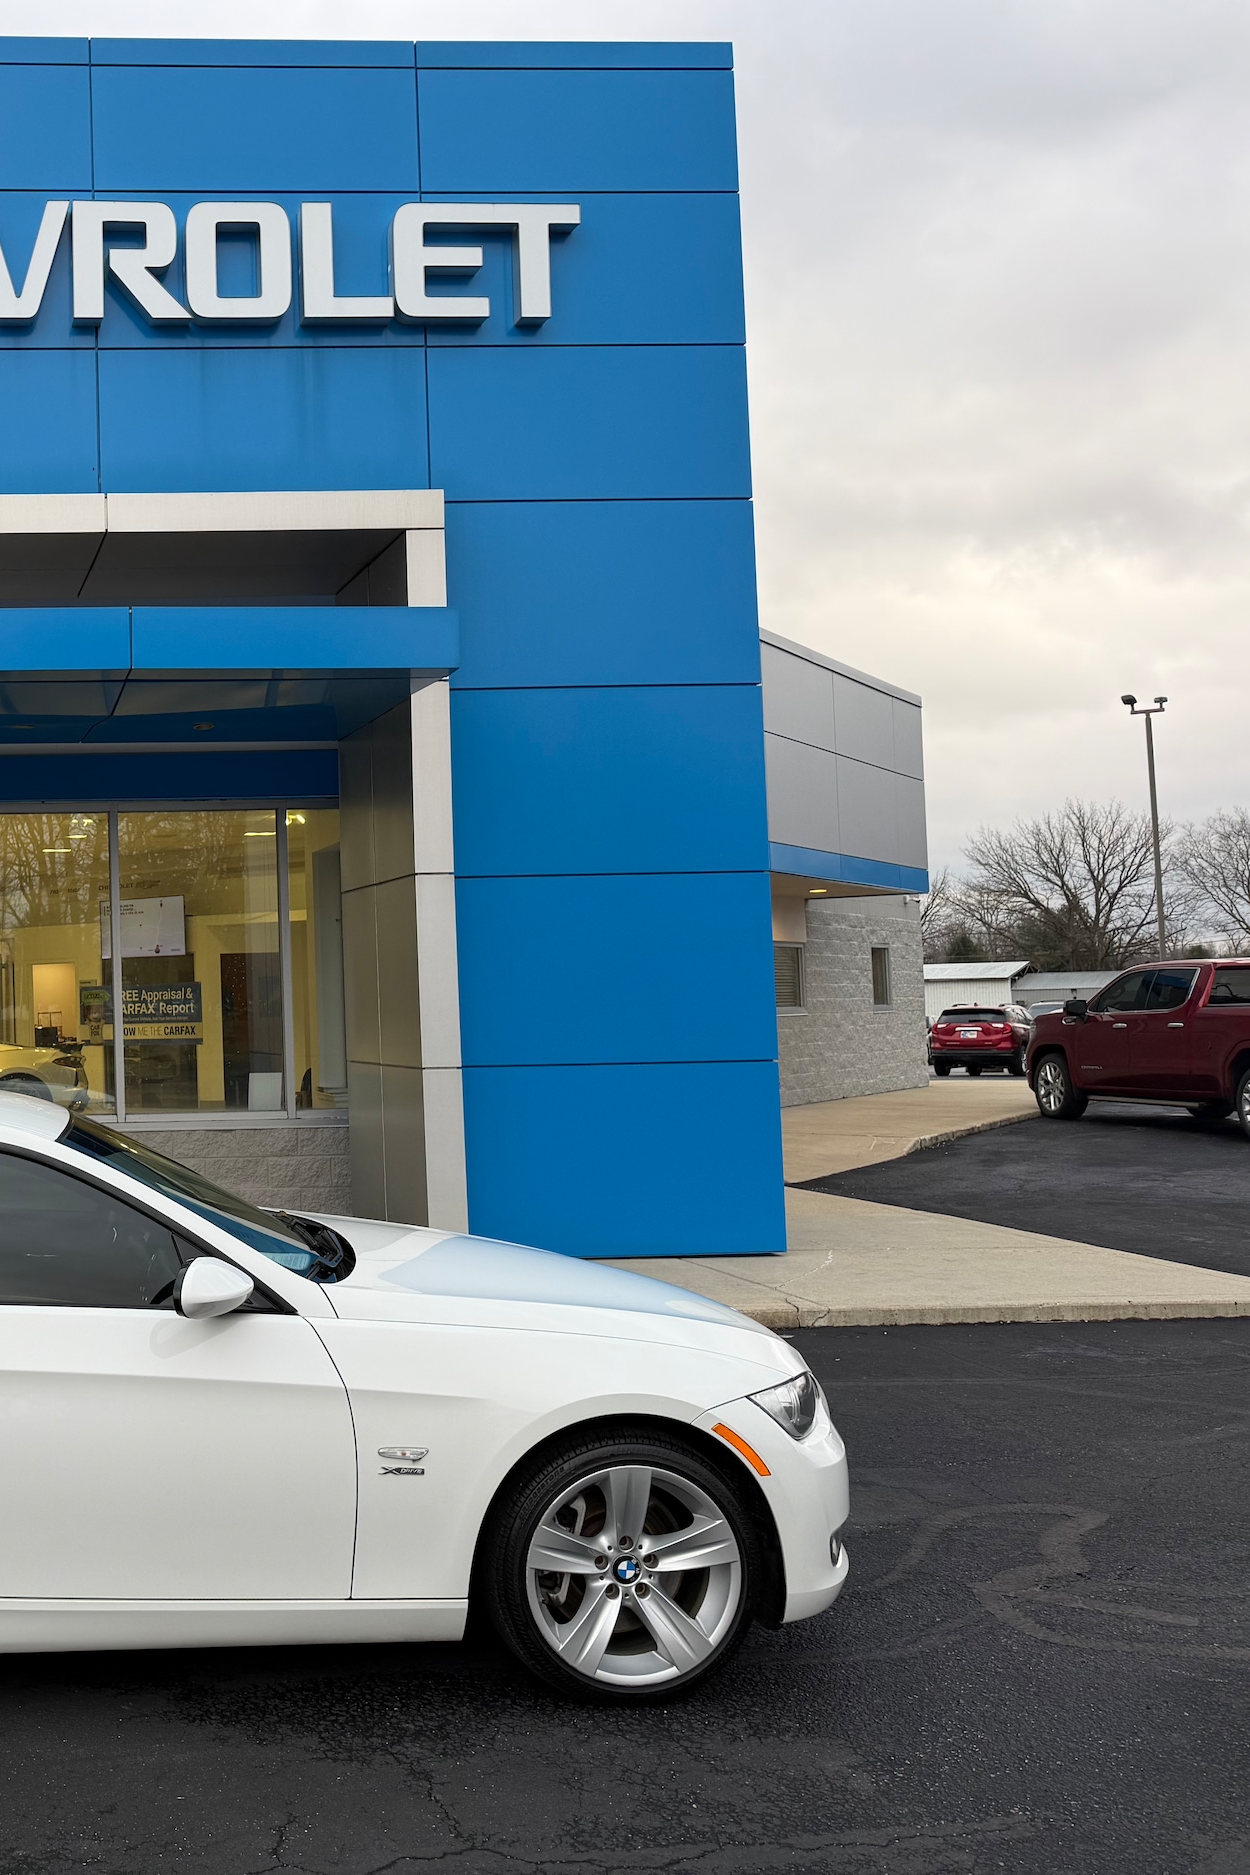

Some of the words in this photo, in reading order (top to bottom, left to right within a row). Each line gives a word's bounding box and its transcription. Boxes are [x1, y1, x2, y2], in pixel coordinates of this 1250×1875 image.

[121, 989, 139, 1001] REE
[141, 987, 185, 1003] Appraisal
[186, 987, 193, 999] &
[122, 1003, 154, 1015] ARFAX
[159, 1002, 194, 1015] Report
[123, 1027, 136, 1036] OW
[138, 1027, 148, 1036] ME
[150, 1026, 163, 1036] THE
[164, 1025, 196, 1036] CARFAX
